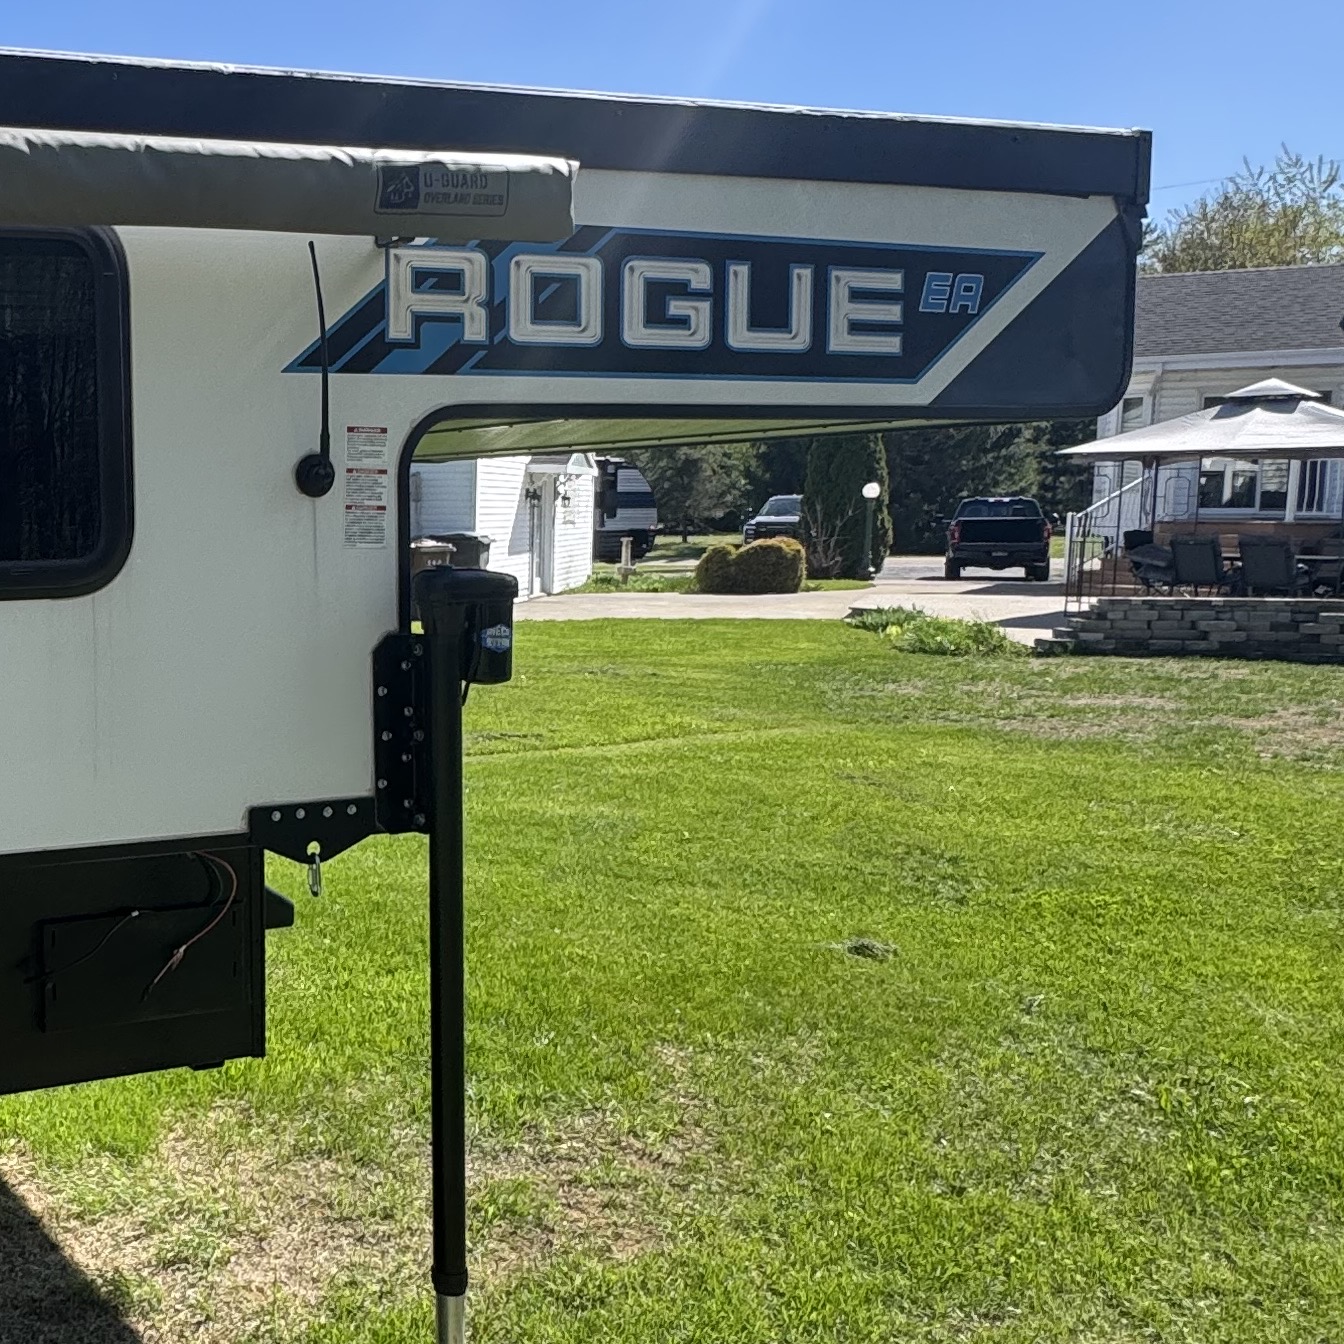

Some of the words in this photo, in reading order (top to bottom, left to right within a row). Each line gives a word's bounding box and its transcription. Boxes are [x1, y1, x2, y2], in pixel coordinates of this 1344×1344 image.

[423, 172, 488, 189] U-GUARD
[385, 246, 904, 355] ROGUE
[919, 271, 984, 314] EA
